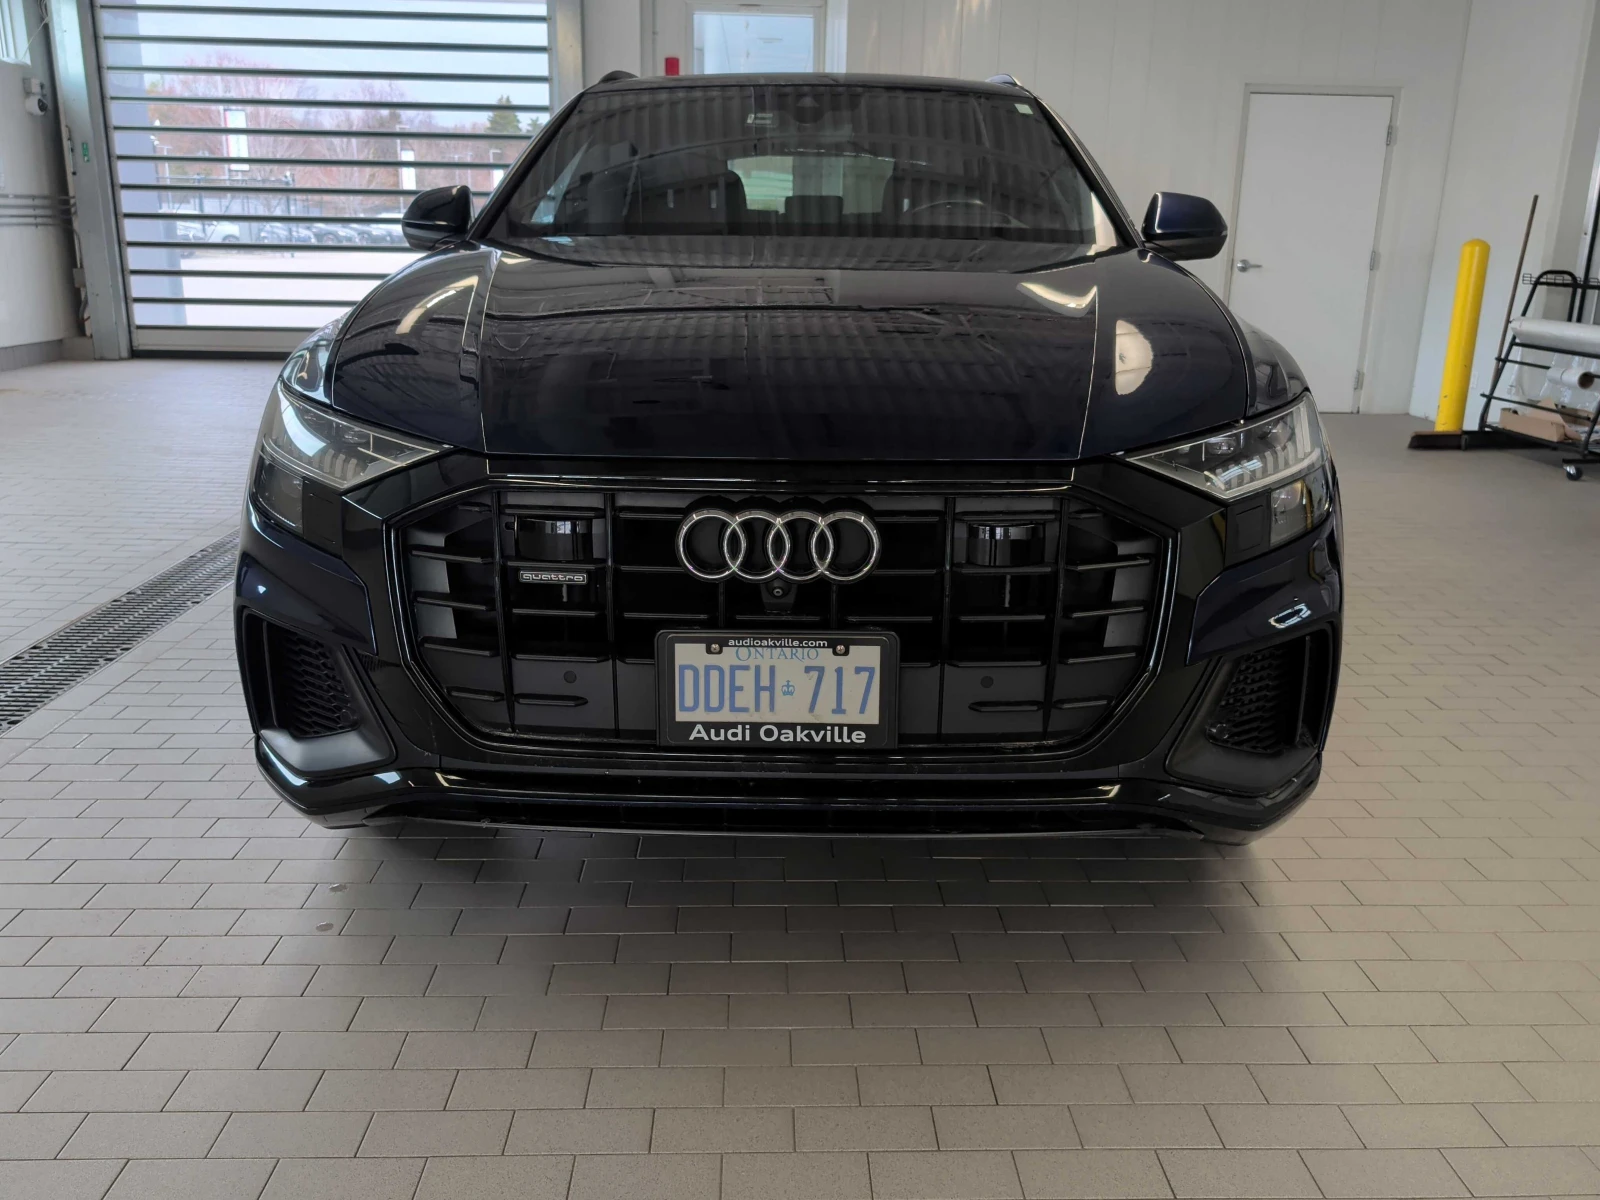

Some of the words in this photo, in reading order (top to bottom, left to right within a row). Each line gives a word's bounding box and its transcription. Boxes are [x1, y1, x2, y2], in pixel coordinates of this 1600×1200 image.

[728, 638, 828, 648] audioakville.com
[735, 647, 819, 662] ONTARIO
[678, 664, 776, 713] DDEH
[804, 665, 876, 715] 717
[689, 724, 750, 742] Audi
[759, 725, 867, 743] Oakville
